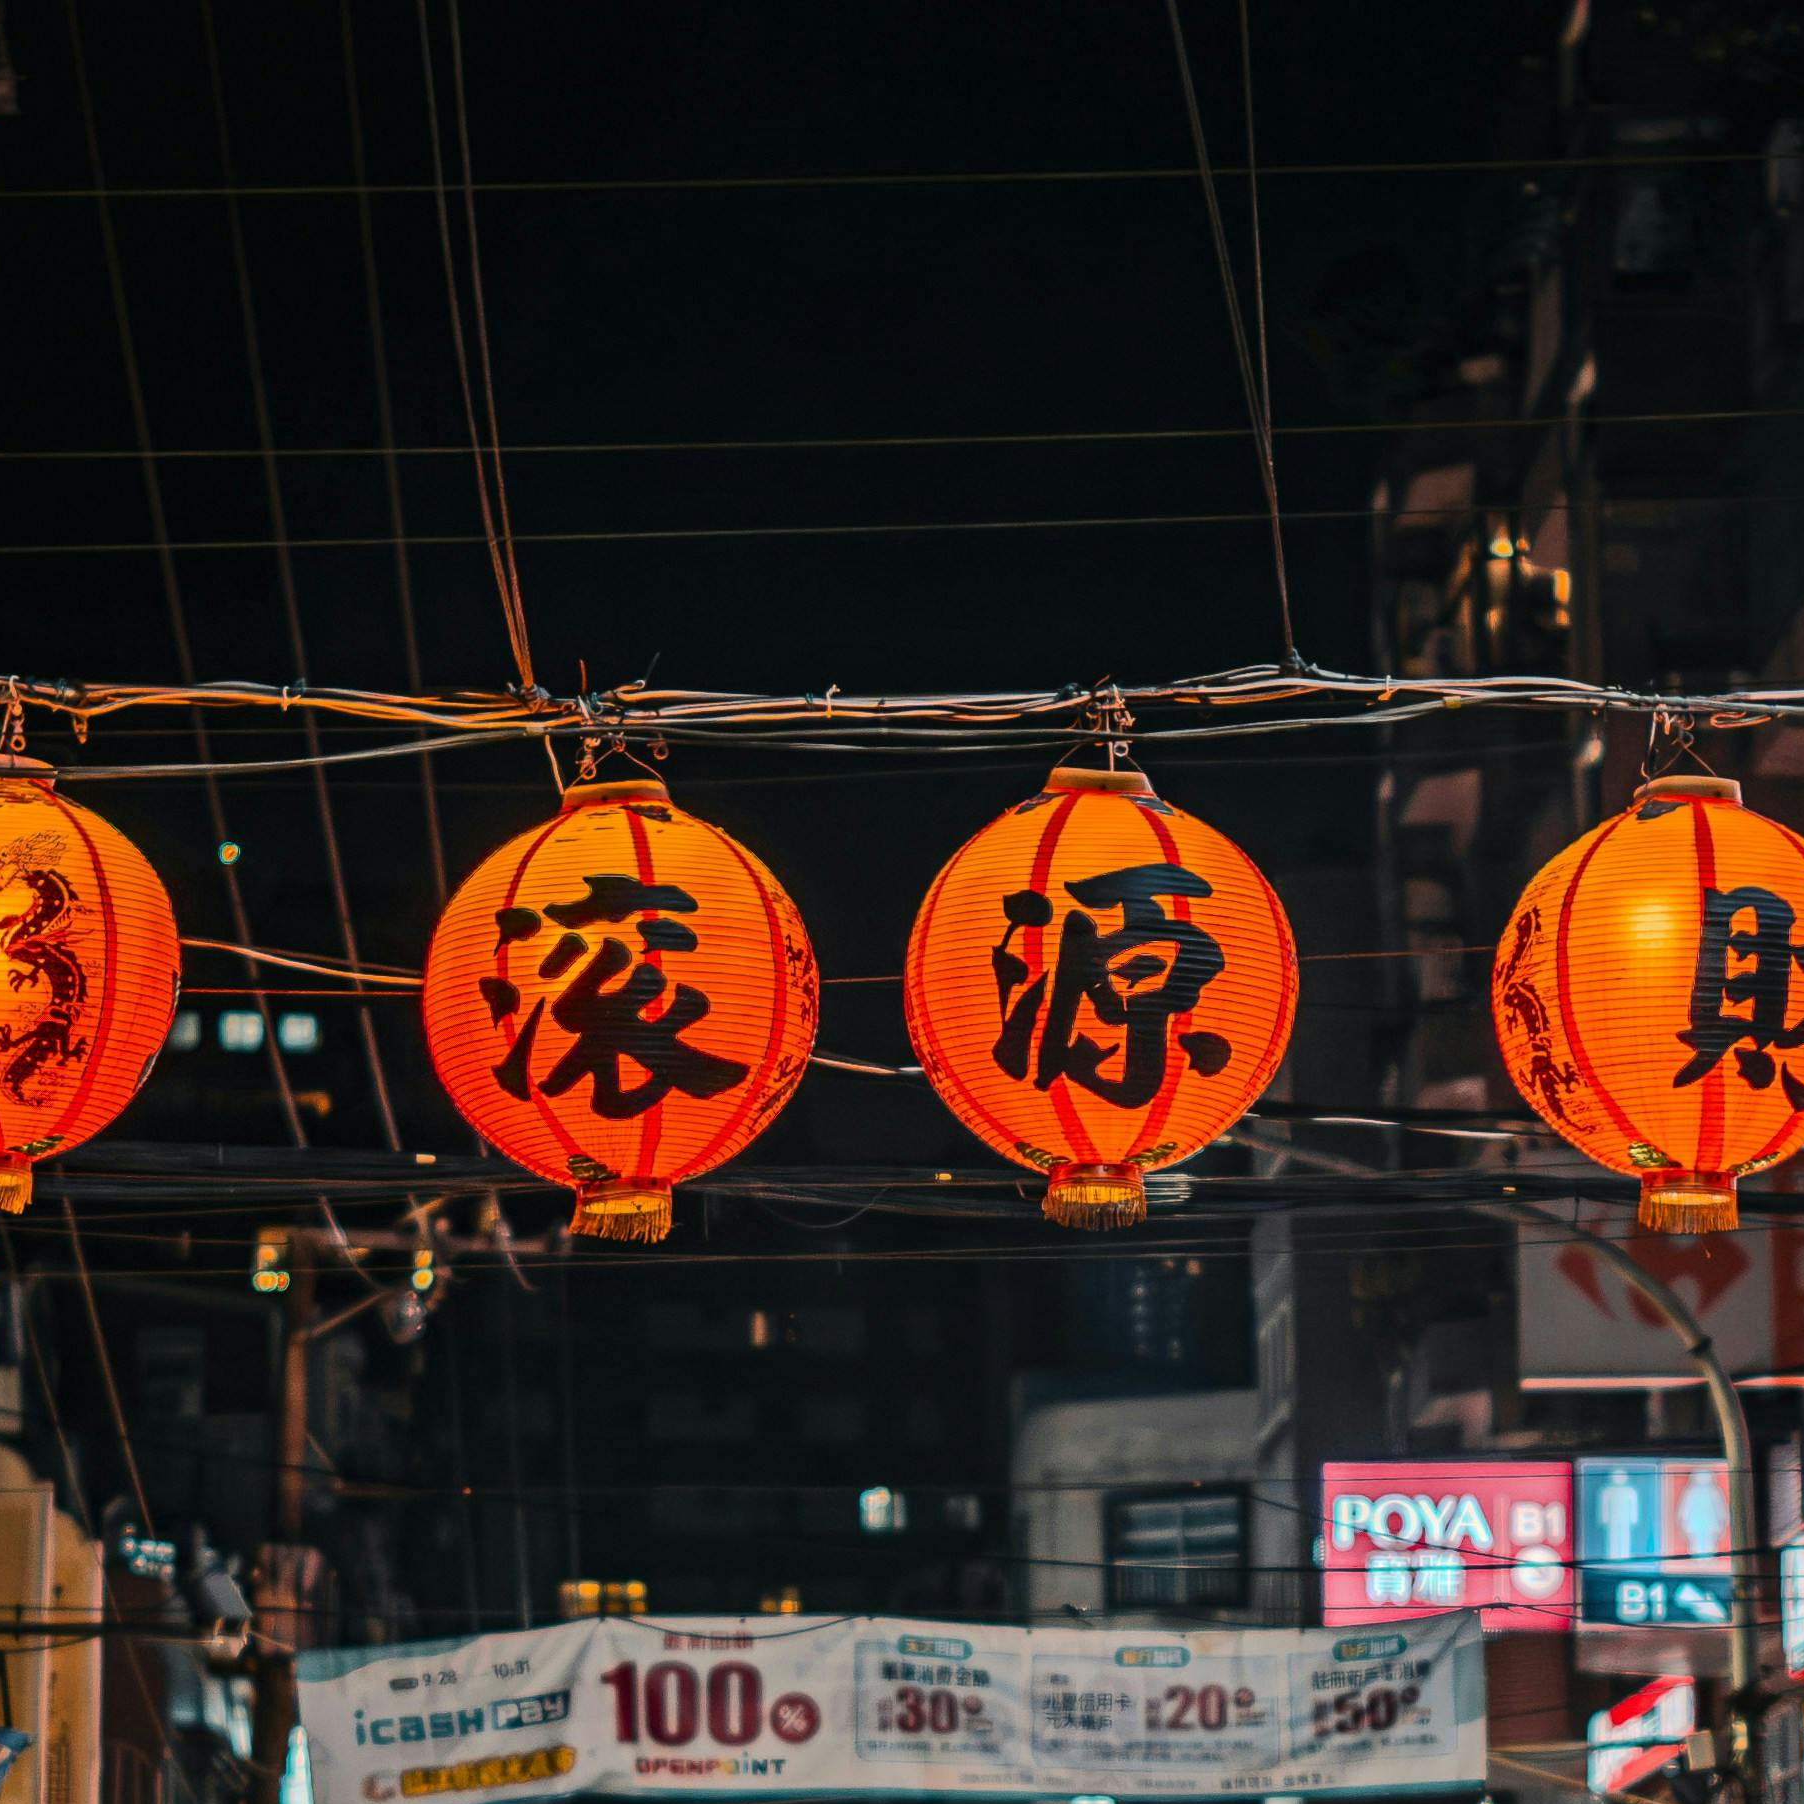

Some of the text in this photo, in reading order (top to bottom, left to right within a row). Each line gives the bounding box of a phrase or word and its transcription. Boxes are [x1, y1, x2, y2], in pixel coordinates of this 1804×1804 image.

[478, 872, 750, 1120] 滾
[992, 862, 1232, 1110] 源
[1332, 1494, 1567, 1550] POYA B1
[1615, 1582, 1667, 1622] B1
[601, 1660, 821, 1746] 100%
